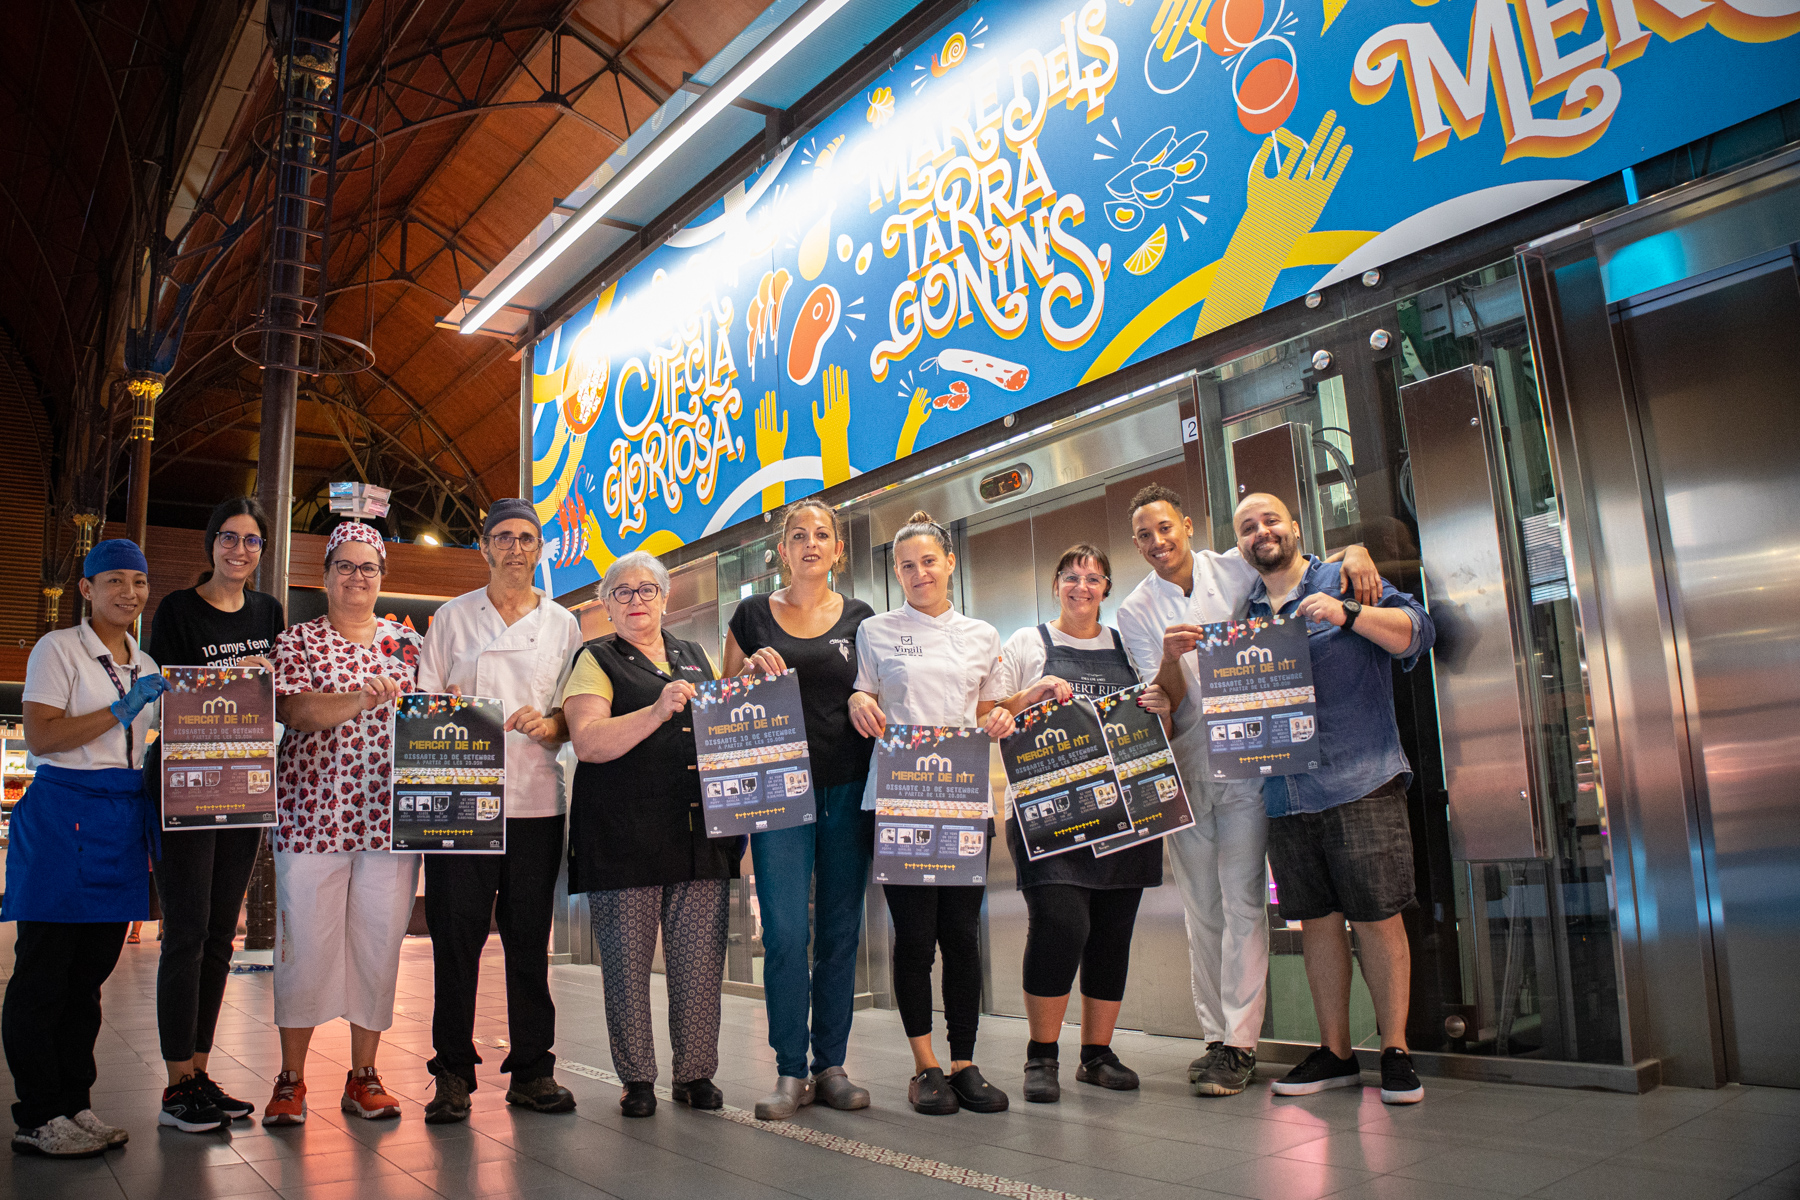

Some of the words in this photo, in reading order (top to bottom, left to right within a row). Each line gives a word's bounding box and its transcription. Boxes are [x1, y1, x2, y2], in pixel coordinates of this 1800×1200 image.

[1350, 0, 1800, 164] ME
[1187, 421, 1197, 438] 2
[202, 644, 218, 658] 10
[219, 642, 247, 655] anys
[246, 638, 271, 651] fent
[894, 645, 923, 654] Virgili
[1214, 665, 1256, 678] MERCAT
[1260, 662, 1274, 673] DE
[178, 714, 220, 724] MERCAT
[224, 714, 238, 724] DE
[708, 722, 750, 735] MERCAT
[754, 719, 768, 728] DE
[409, 740, 451, 750] MERCAT
[455, 741, 468, 750] DE
[1117, 735, 1131, 746] DE
[1016, 746, 1054, 764] MERCAT
[1057, 741, 1071, 751] DE
[892, 770, 934, 782] MERCAT
[938, 773, 952, 782] DE
